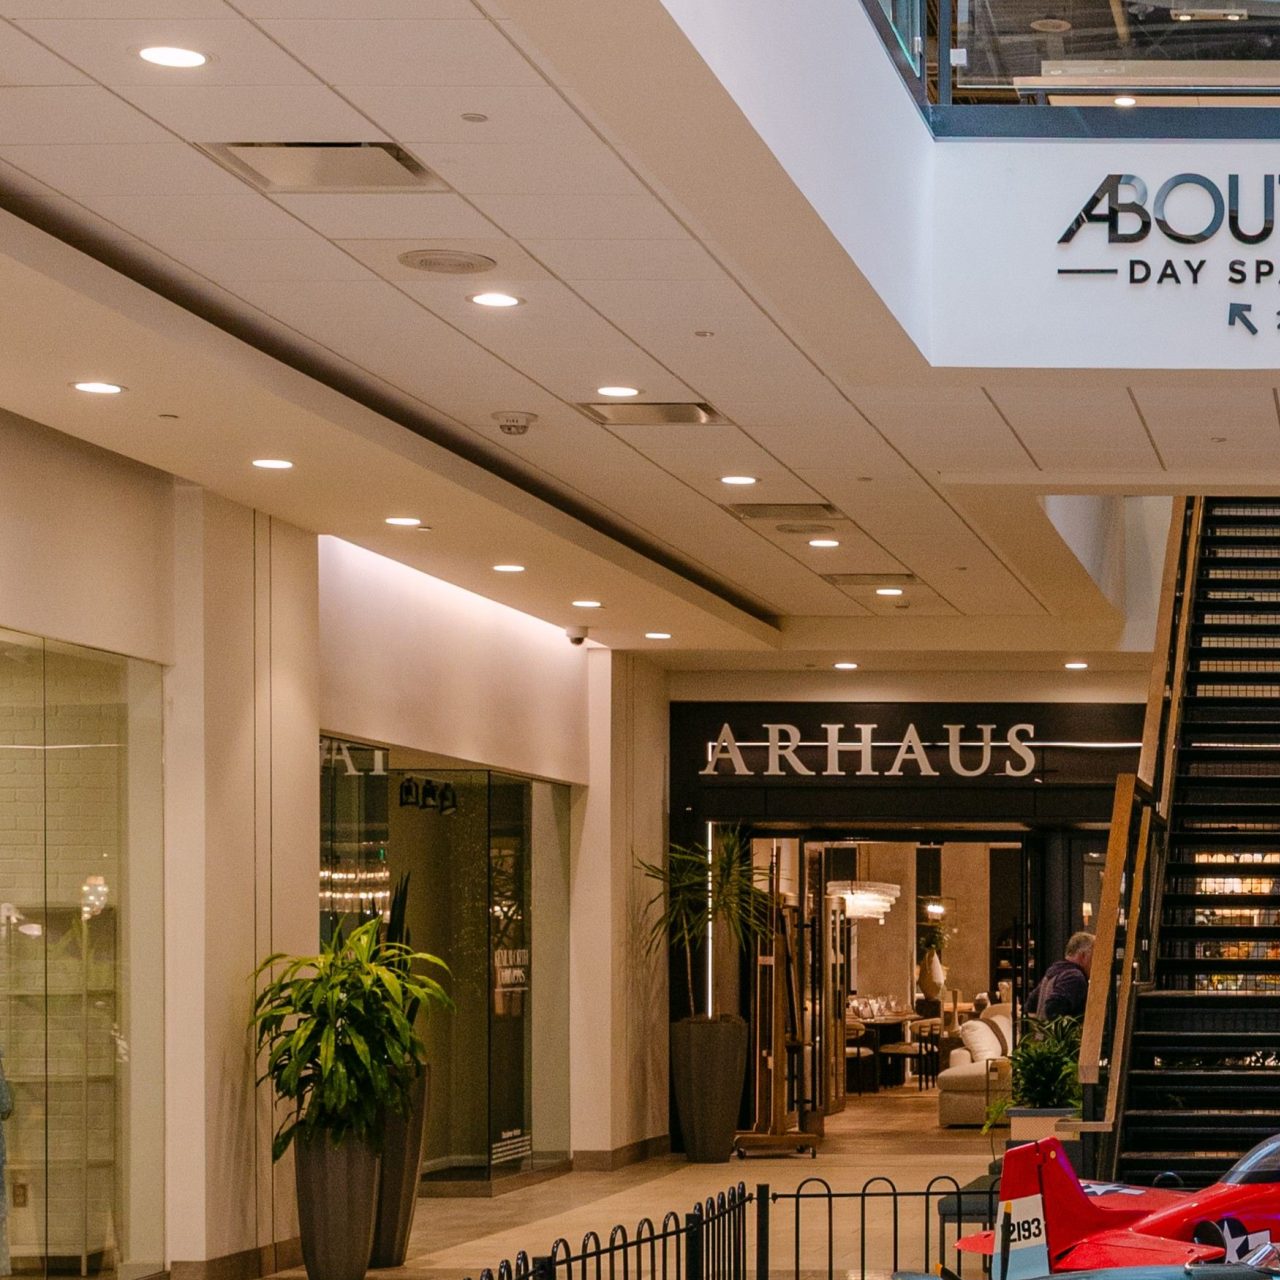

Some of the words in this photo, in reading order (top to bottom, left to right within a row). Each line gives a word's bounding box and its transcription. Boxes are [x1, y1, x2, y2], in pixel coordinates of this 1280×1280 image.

[1129, 259, 1207, 285] DAY
[699, 722, 1036, 777] ARHAUS
[1009, 1218, 1042, 1243] 2193
